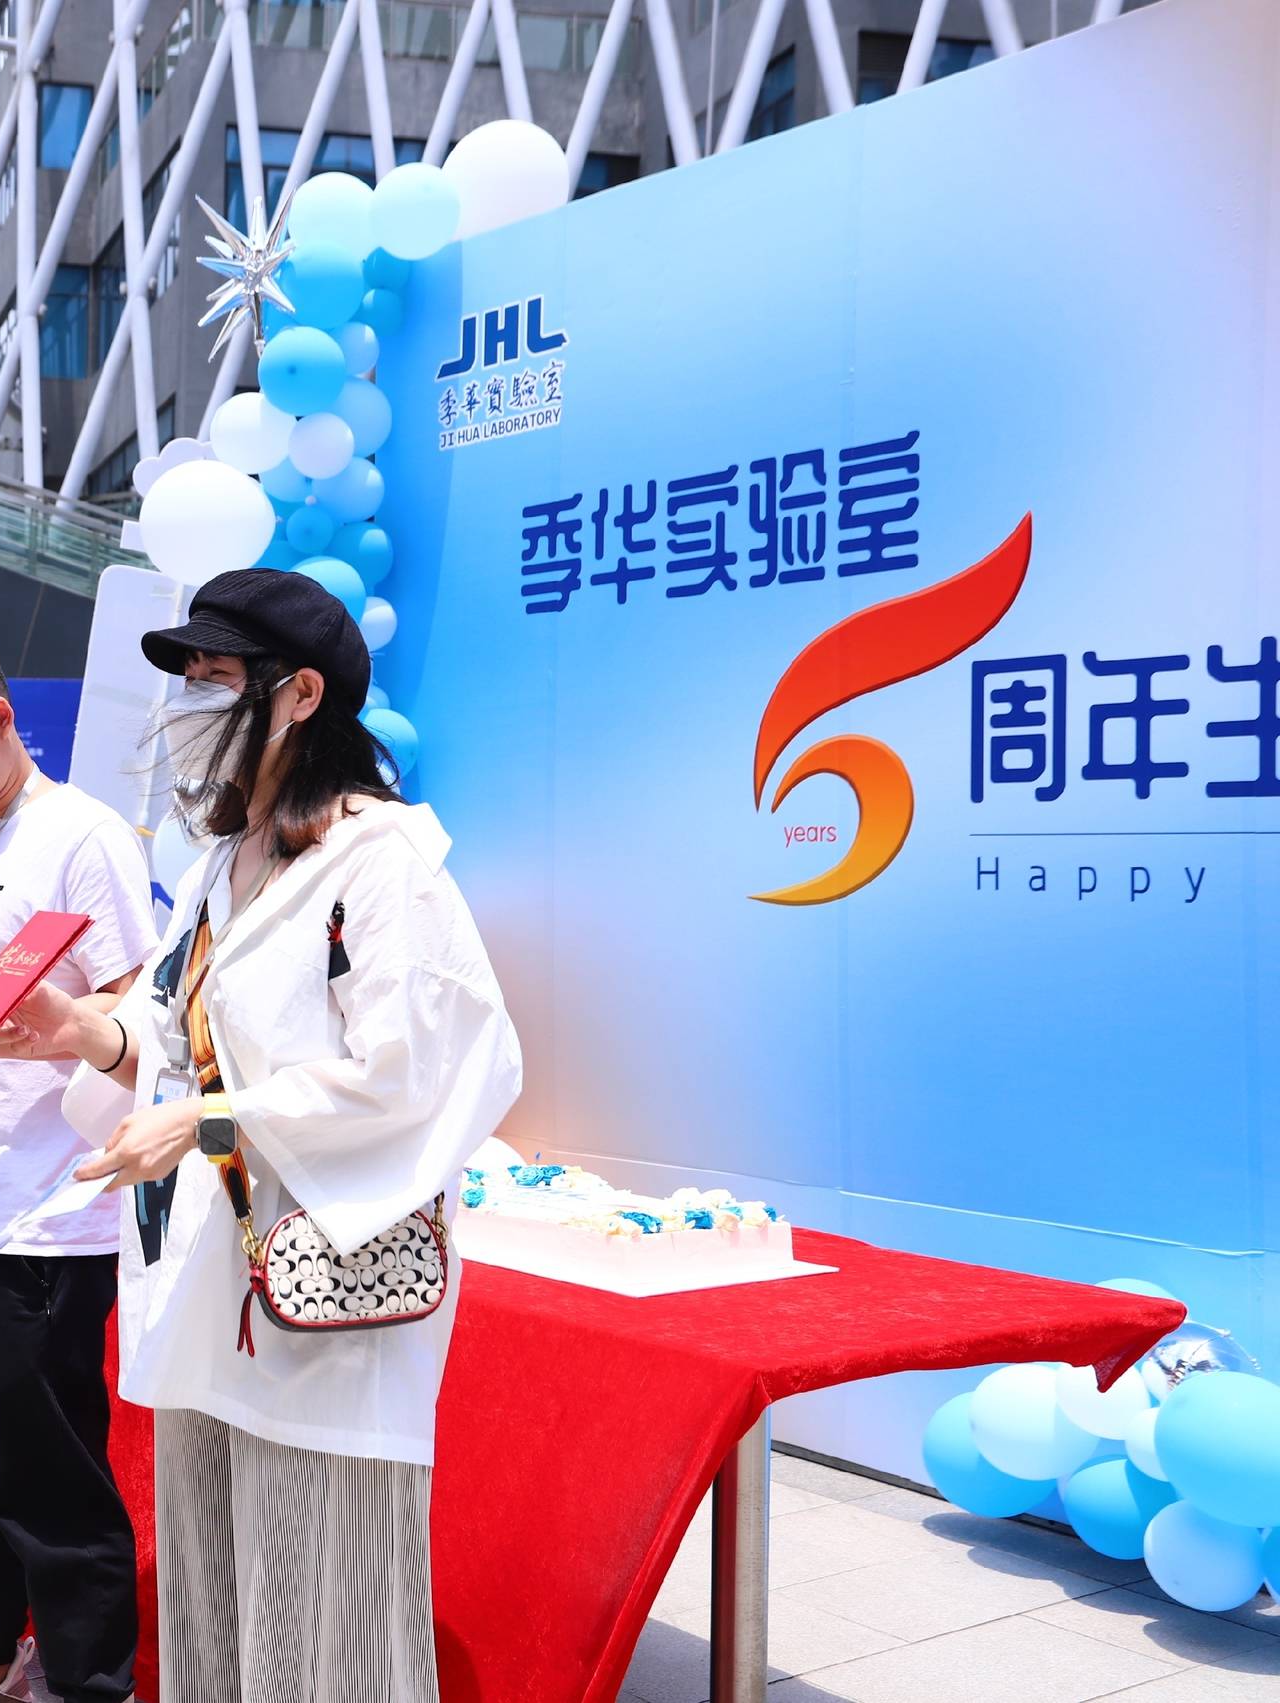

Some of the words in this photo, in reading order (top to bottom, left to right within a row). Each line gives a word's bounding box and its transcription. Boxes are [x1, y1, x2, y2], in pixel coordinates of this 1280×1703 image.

[437, 297, 567, 380] JHL
[440, 431, 455, 448] JI
[457, 425, 480, 444] HUA
[483, 407, 561, 438] LABORATORY
[521, 430, 920, 615] 季华实验室
[784, 825, 837, 848] years
[975, 855, 1206, 904] Happy
